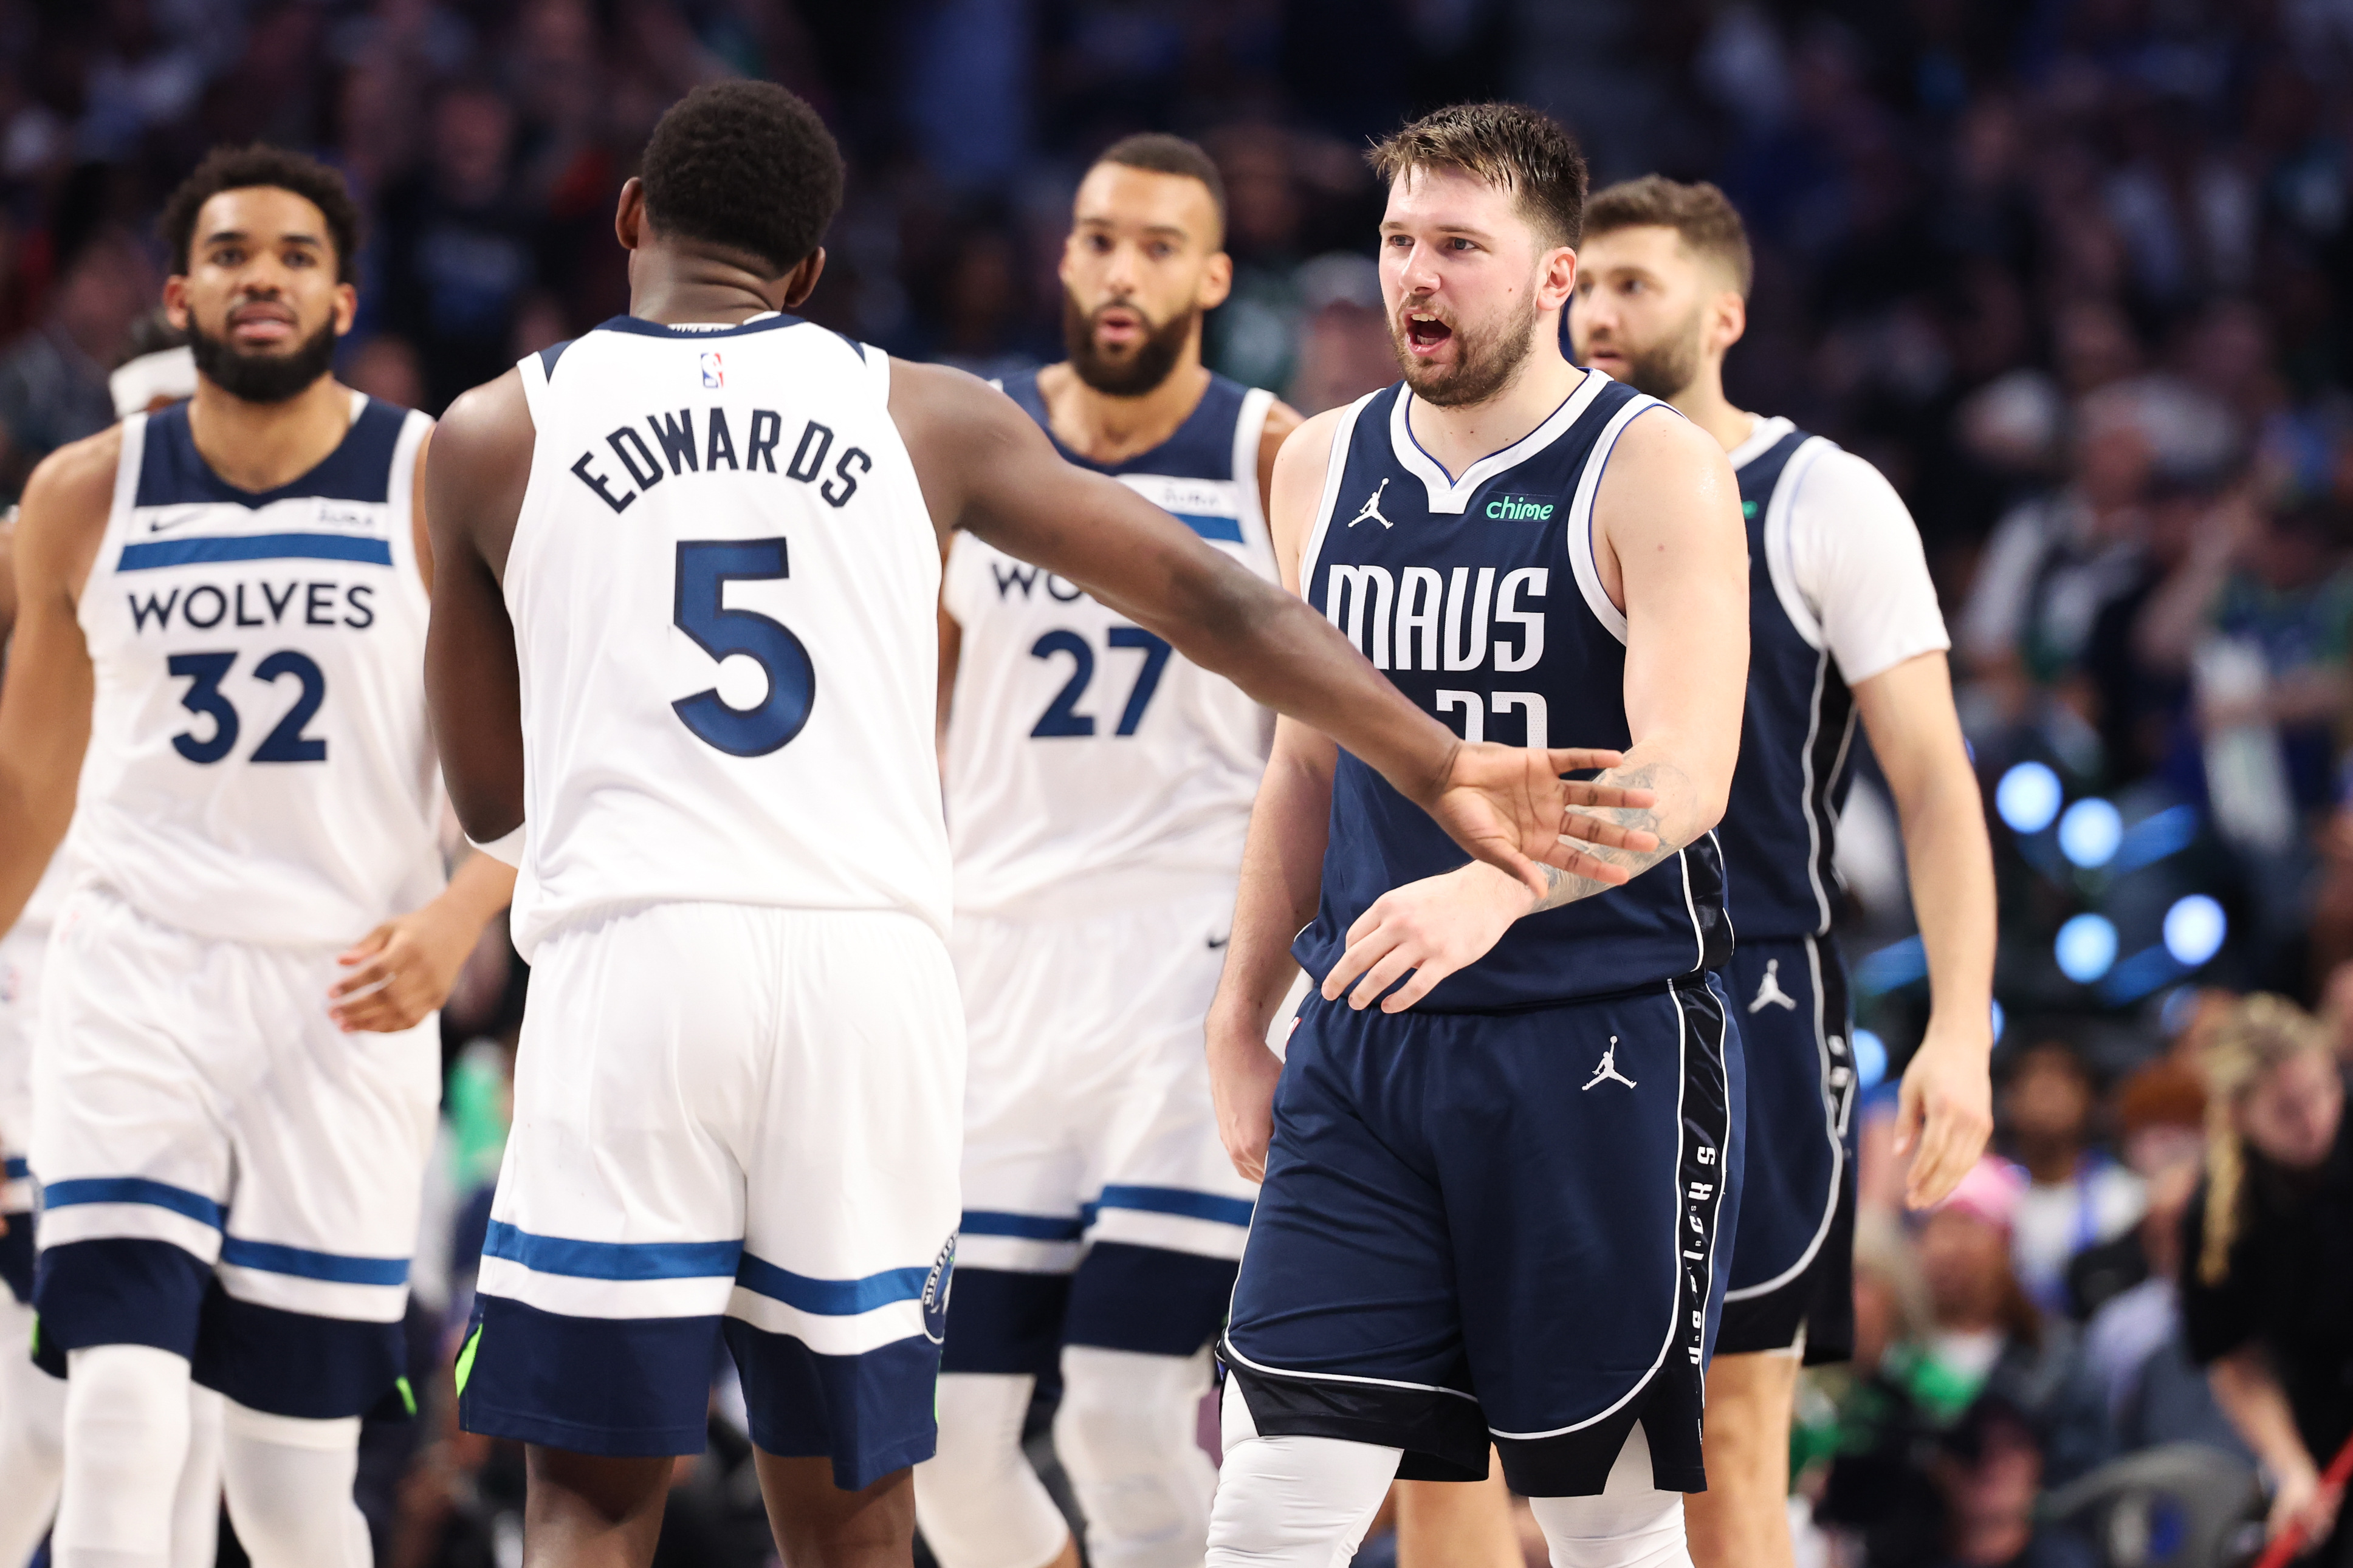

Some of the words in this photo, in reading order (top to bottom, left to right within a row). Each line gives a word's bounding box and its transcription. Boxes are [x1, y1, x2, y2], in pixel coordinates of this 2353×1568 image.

[570, 407, 872, 514] EDWARDS
[1486, 496, 1554, 521] chime
[128, 582, 374, 631] WOLVES
[671, 536, 816, 758] 5
[1326, 564, 1549, 672] MAVS
[166, 649, 327, 765] 32
[1030, 627, 1173, 738] 27
